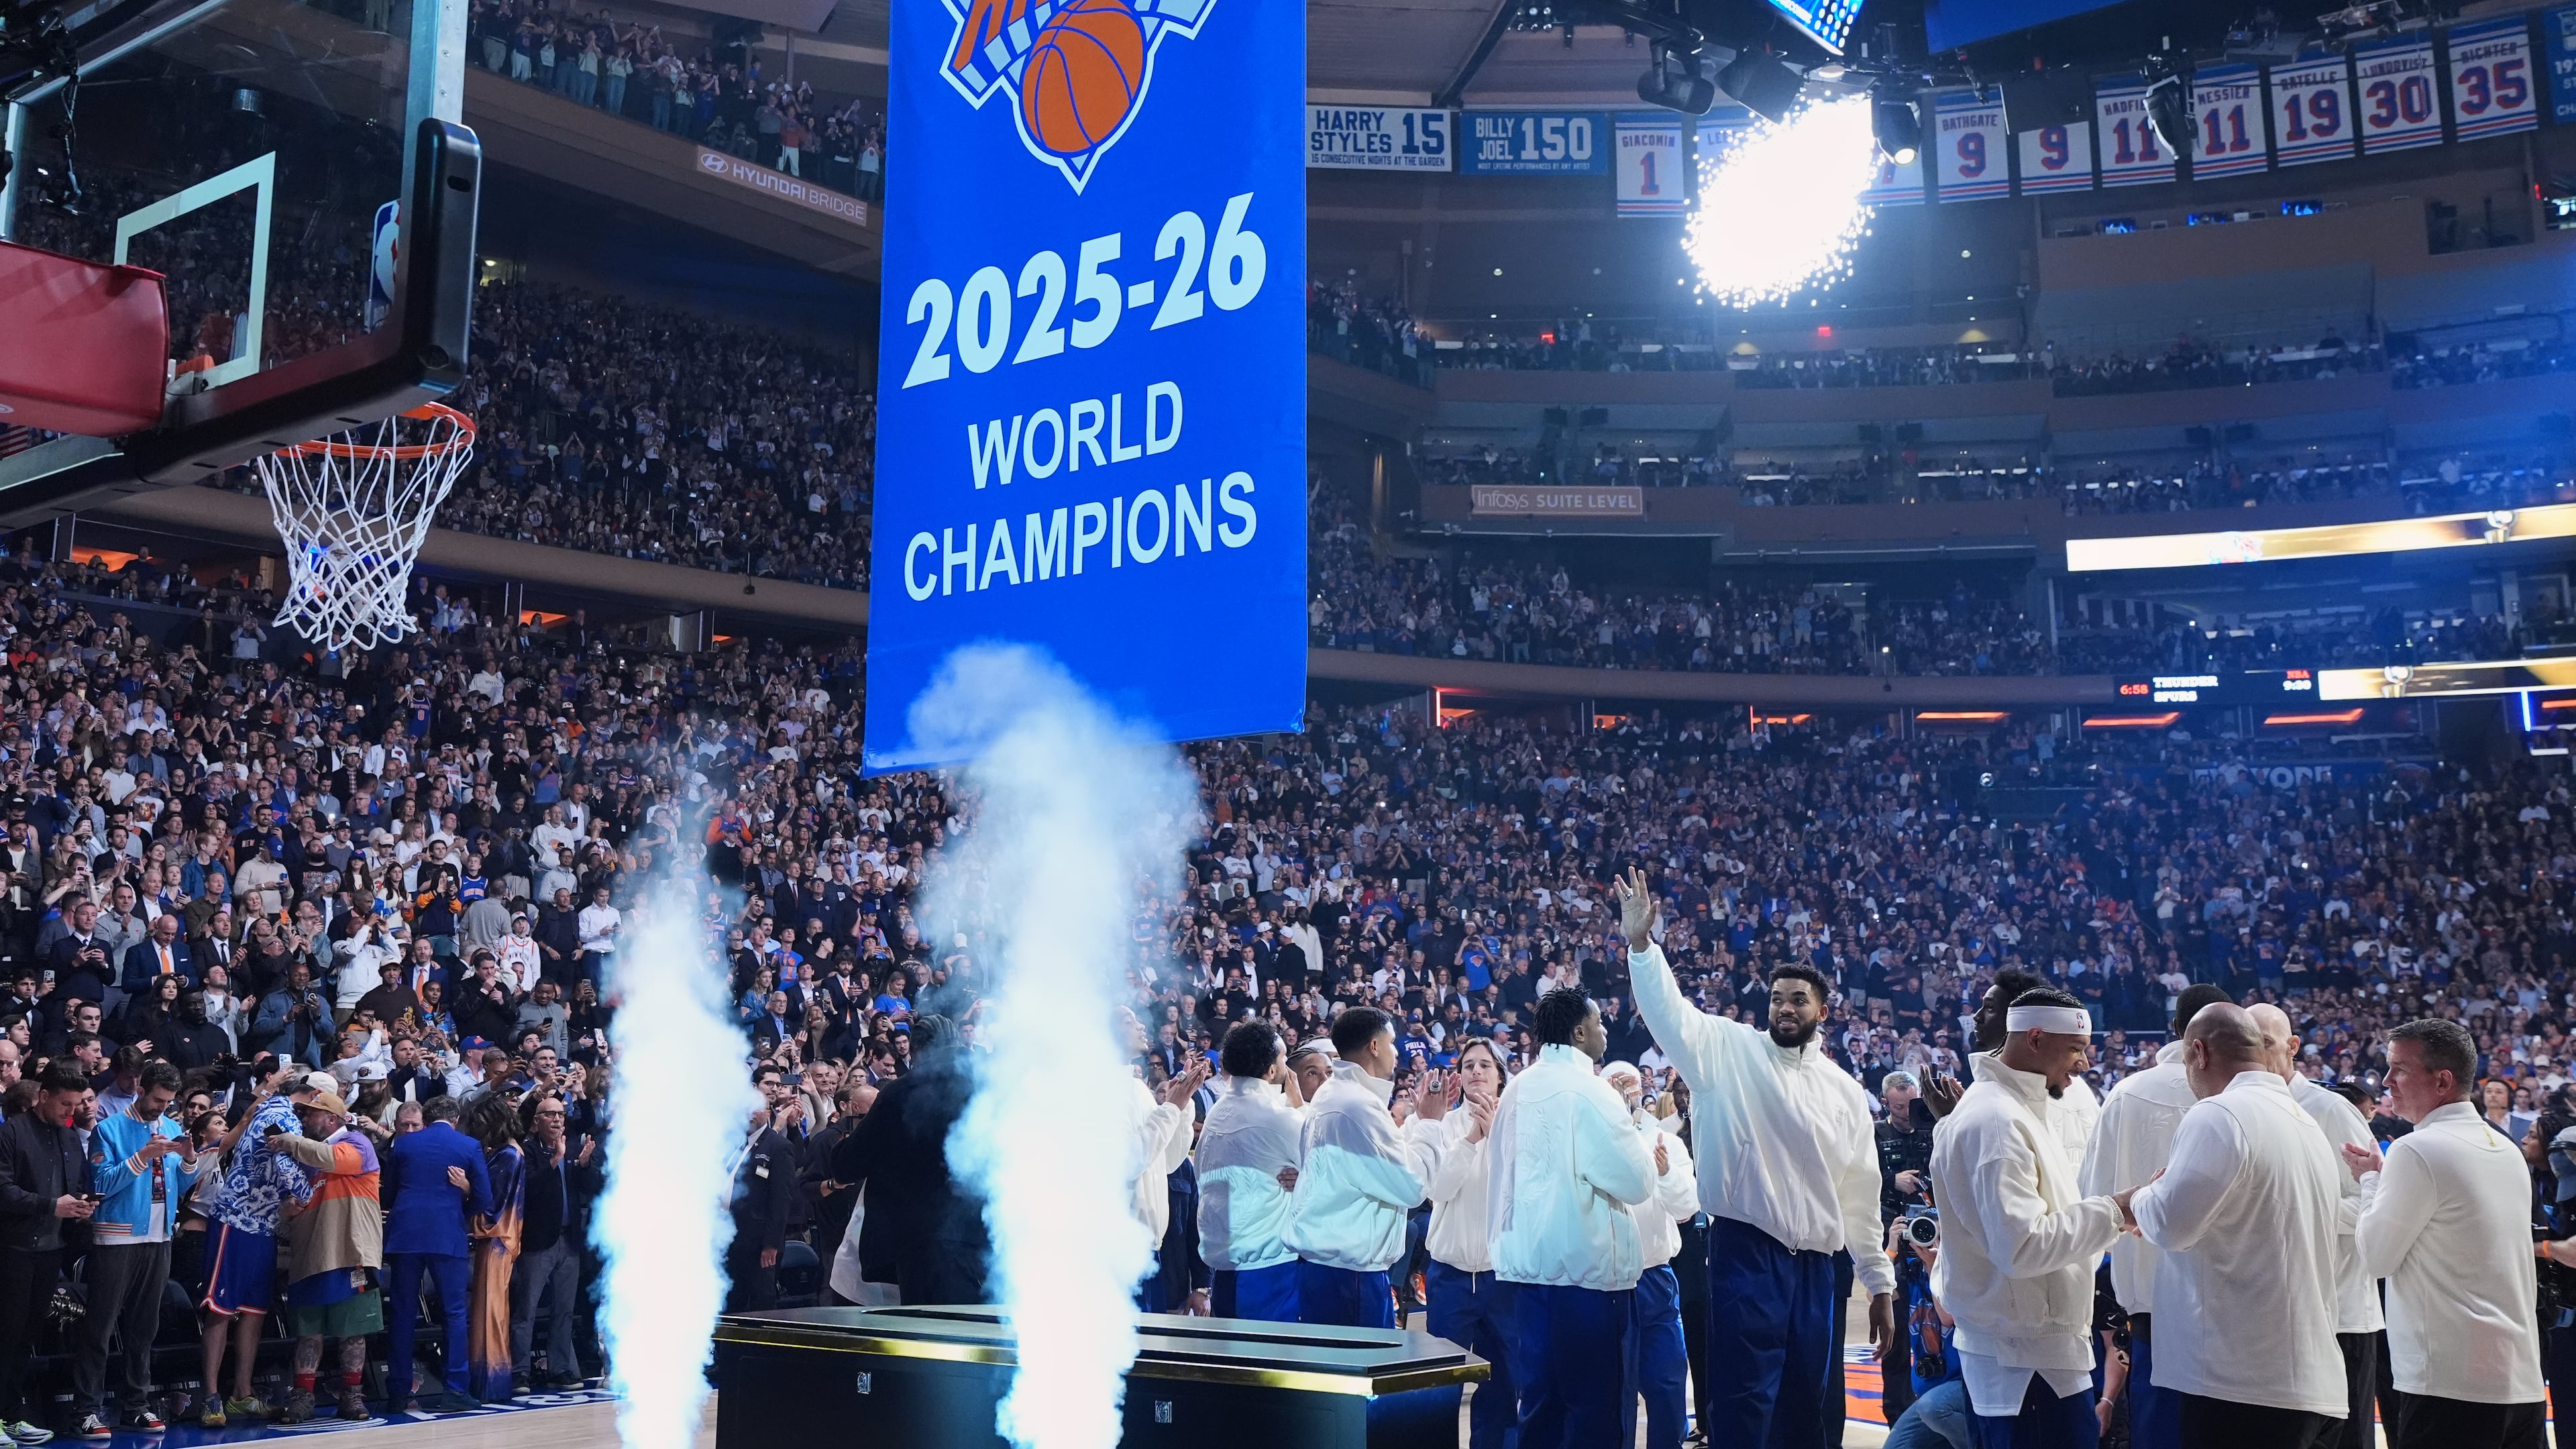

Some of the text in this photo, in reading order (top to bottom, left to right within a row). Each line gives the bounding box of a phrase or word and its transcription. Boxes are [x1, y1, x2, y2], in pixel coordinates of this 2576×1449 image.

[2366, 74, 2432, 129] 30
[2457, 58, 2528, 115] 35
[1316, 110, 1385, 131] HARRY
[1941, 113, 1998, 131] BATHGATE
[2104, 99, 2145, 116] HADFIE
[2284, 89, 2341, 142] 19
[1311, 131, 1392, 154] STYLES
[1401, 113, 1444, 154] 15
[1475, 117, 1515, 138] BILLY
[1521, 117, 1593, 160] 150
[1621, 135, 1676, 148] GIACOMIN
[2113, 115, 2159, 164] 11
[2203, 103, 2251, 156] 11
[1311, 153, 1445, 167] 15 CONSECUTIVE NIGHTS AT THE GARDEN
[1478, 140, 1514, 160] JOEL
[1957, 131, 1986, 178] 9
[2039, 125, 2069, 170] 9
[1640, 151, 1660, 195] 1
[733, 163, 865, 221] HYUNDAI BRIDGE
[901, 191, 1267, 389] 2025-26
[967, 380, 1183, 490] WORLD
[1478, 490, 1637, 511] Infosys SUITE LEVEL
[904, 471, 1257, 602] CHAMPIONS
[2119, 684, 2149, 695] 6:58
[2153, 676, 2218, 688] THUNDER
[2286, 669, 2310, 680] NBA
[241, 839, 256, 848] NEW
[1404, 1042, 1426, 1051] PHILA
